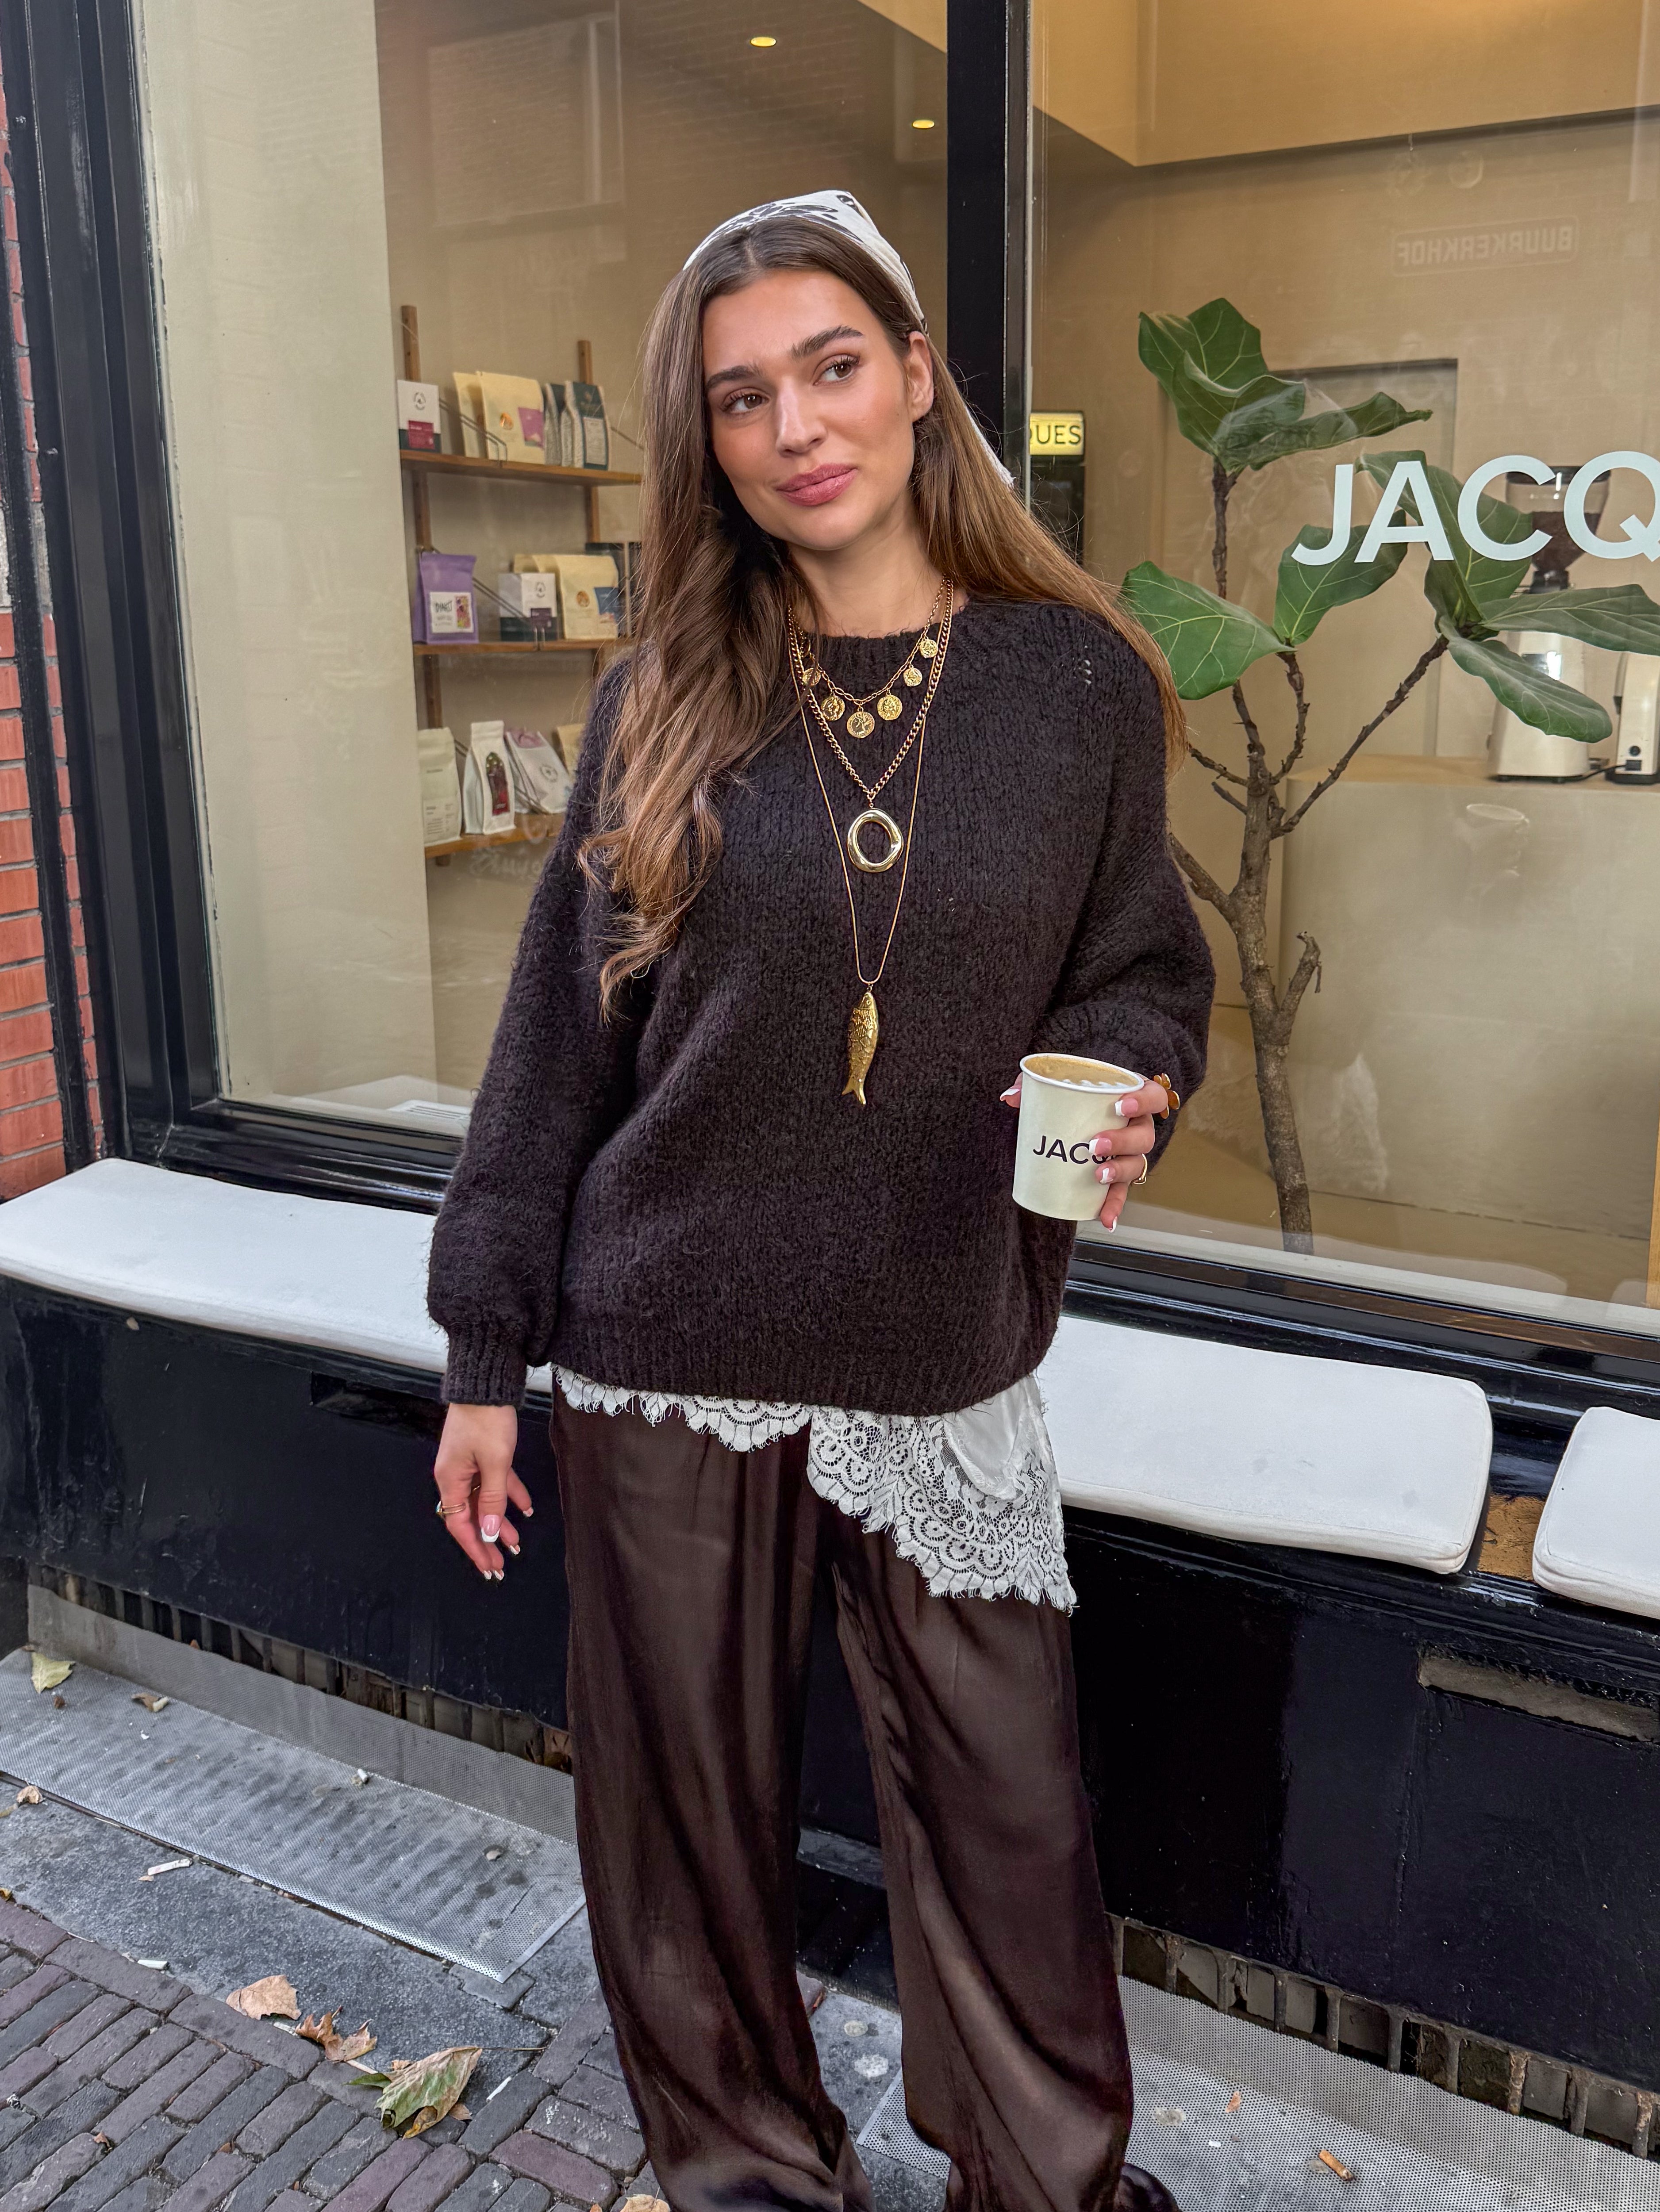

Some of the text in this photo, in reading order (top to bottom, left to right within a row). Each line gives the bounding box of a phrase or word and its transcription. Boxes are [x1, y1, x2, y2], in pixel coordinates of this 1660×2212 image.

[1030, 425, 1081, 445] UES
[1291, 451, 1660, 566] JACQ
[1033, 1135, 1114, 1164] JAC
